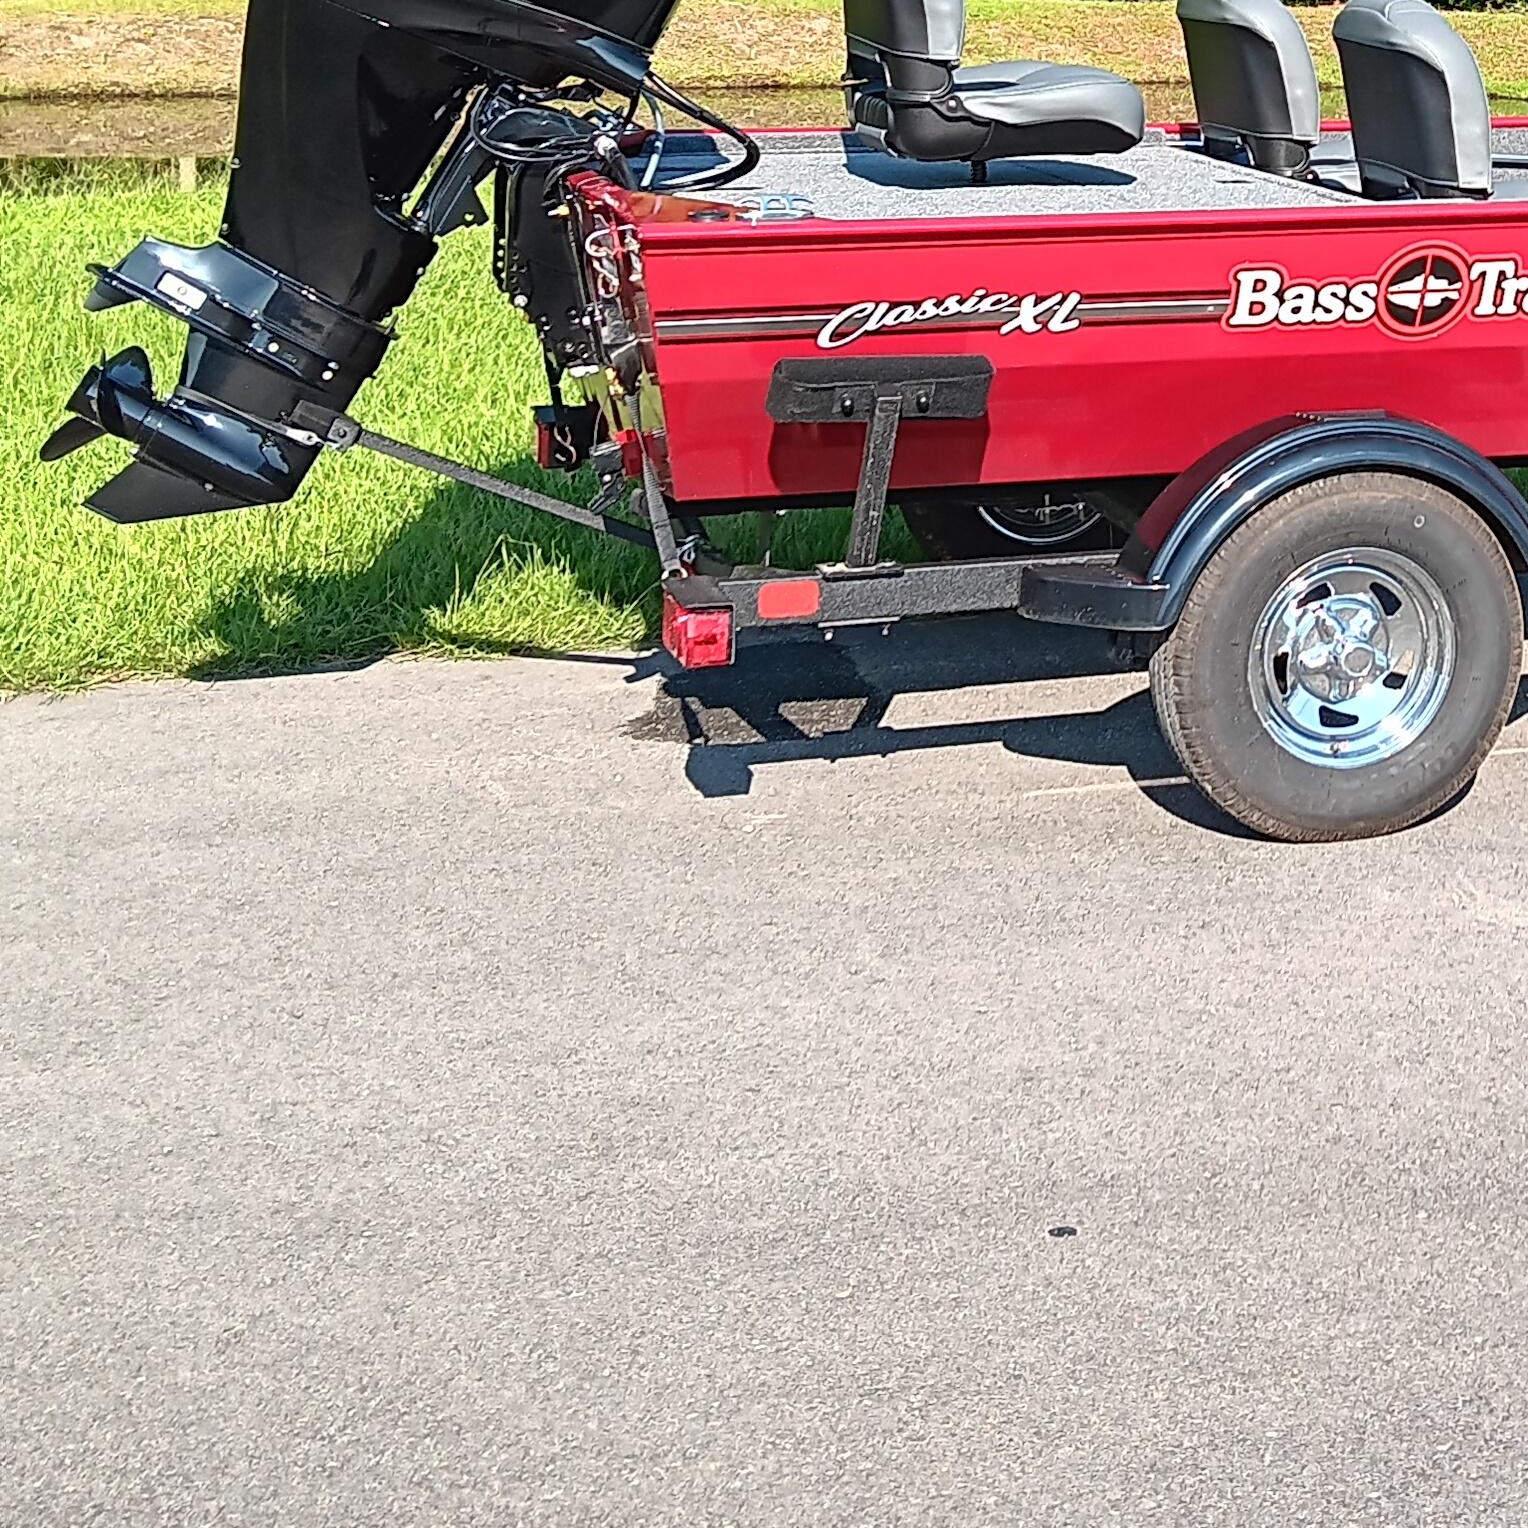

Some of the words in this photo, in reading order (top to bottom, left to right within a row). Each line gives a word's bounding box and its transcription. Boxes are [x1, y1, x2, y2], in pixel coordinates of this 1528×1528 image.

[816, 288, 1018, 348] Classic
[1000, 291, 1081, 335] XL
[1229, 269, 1378, 326] Bass
